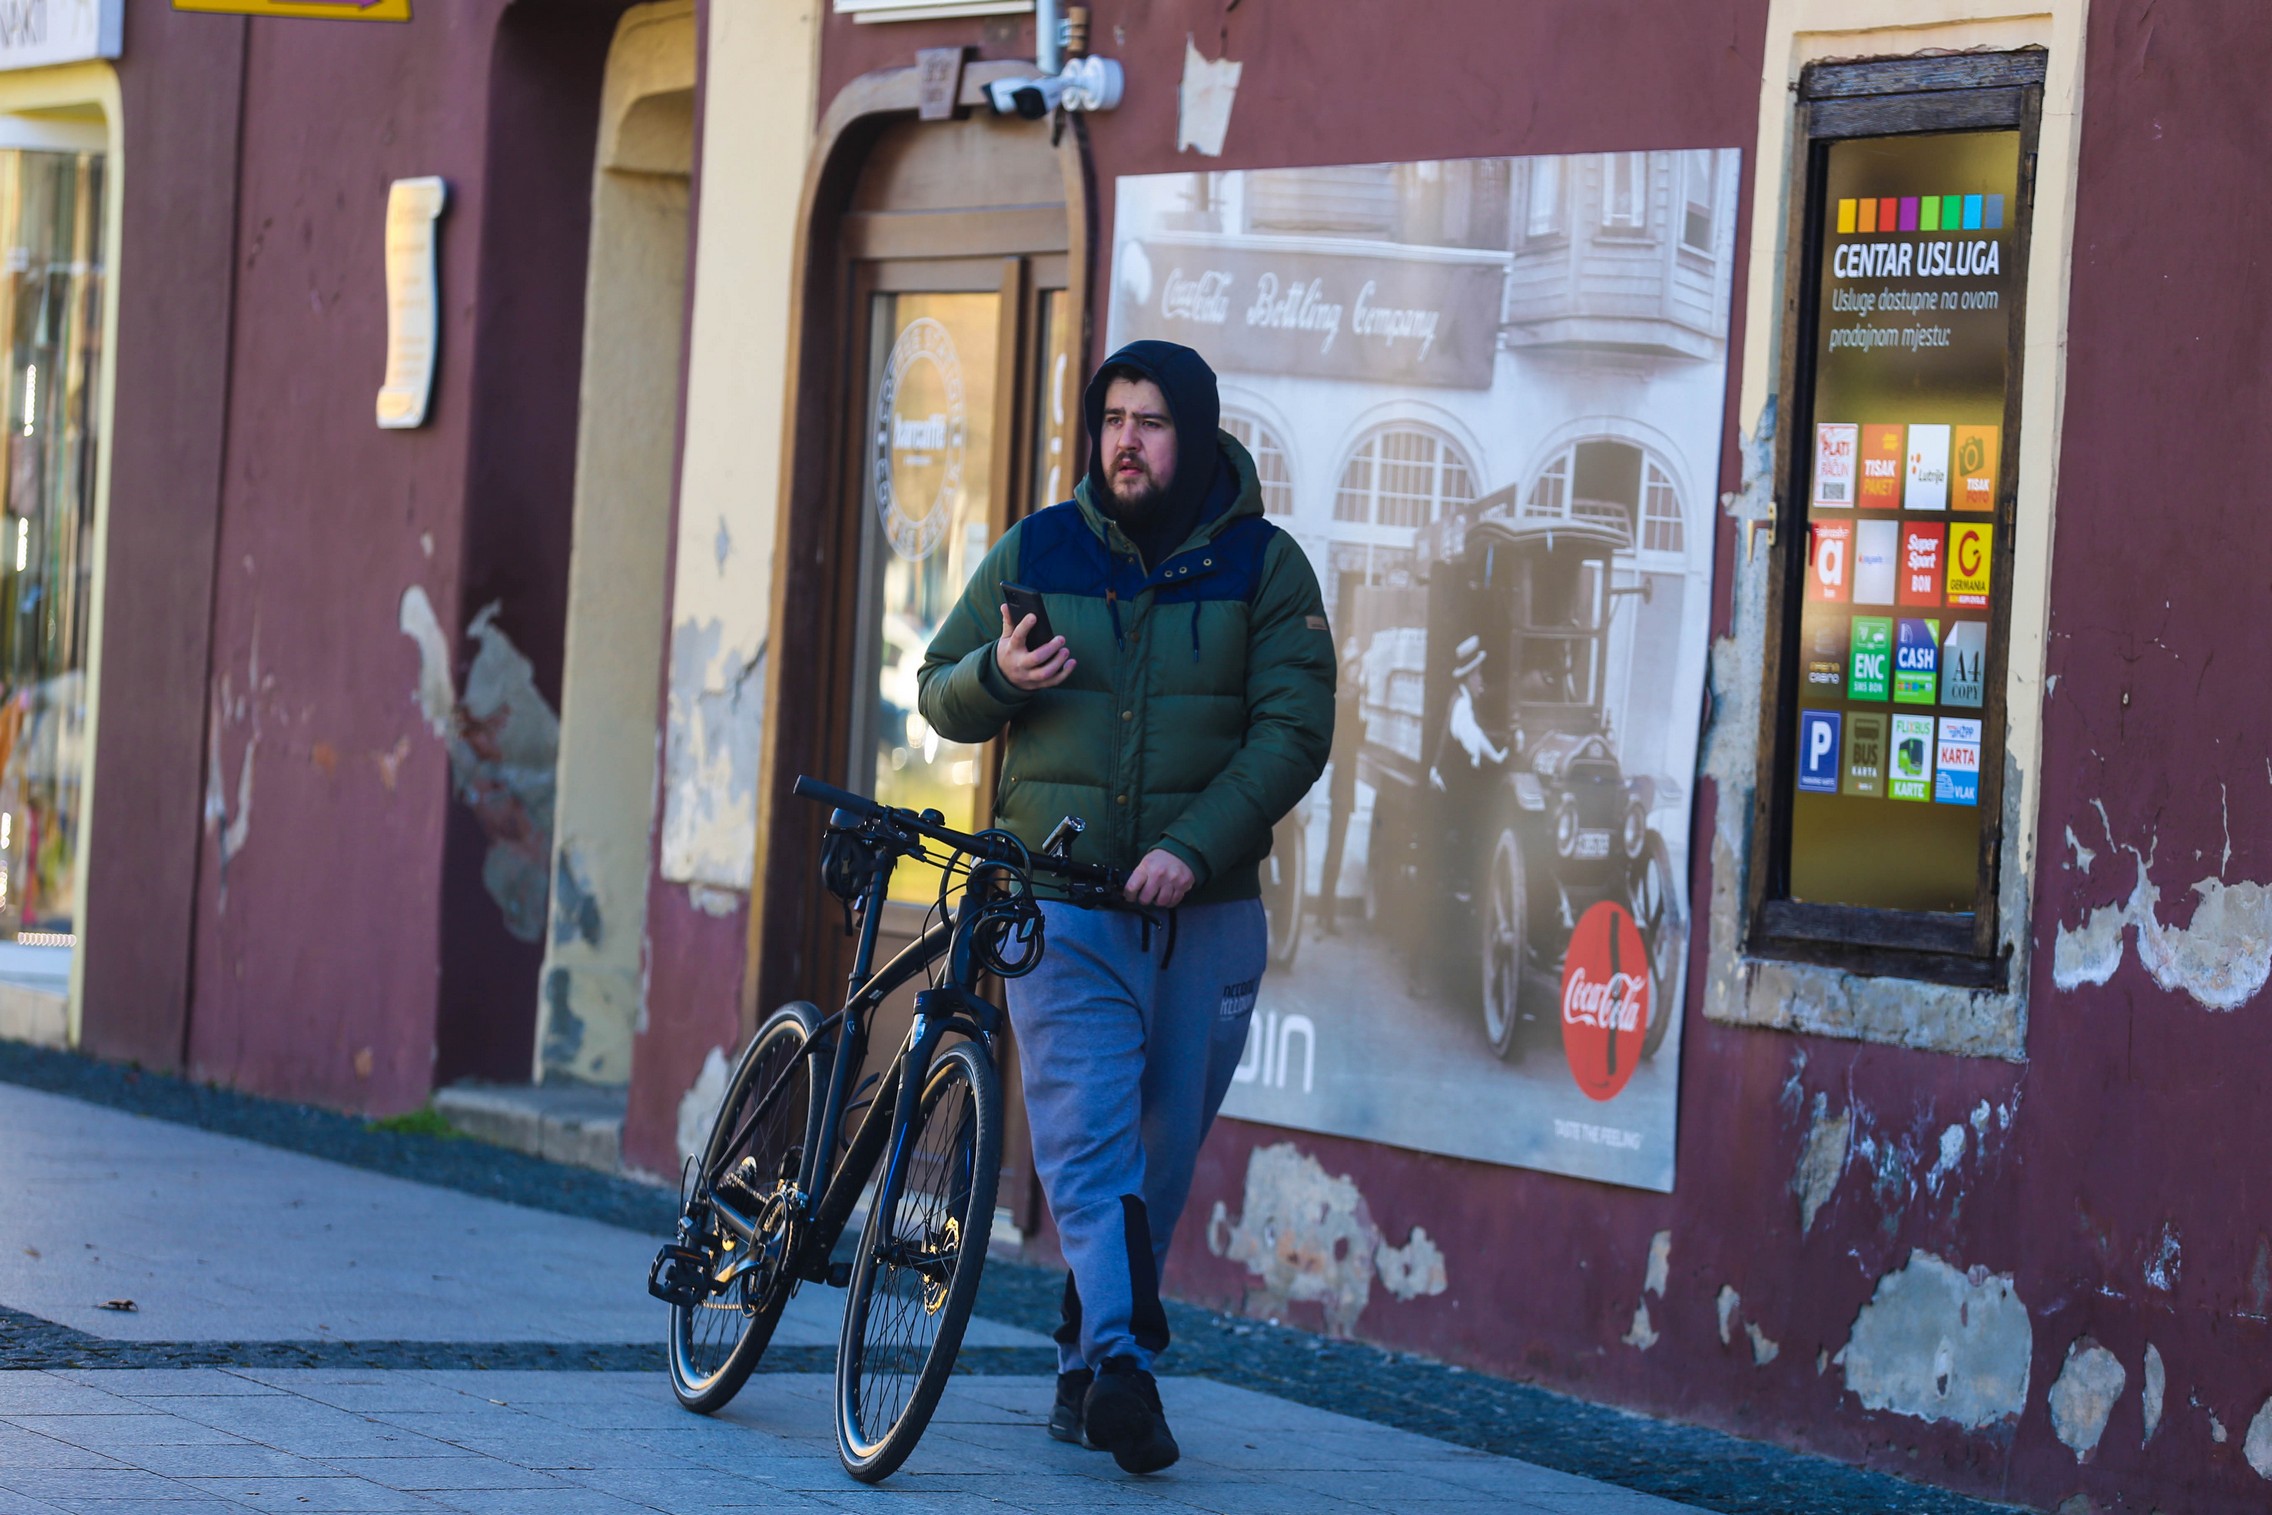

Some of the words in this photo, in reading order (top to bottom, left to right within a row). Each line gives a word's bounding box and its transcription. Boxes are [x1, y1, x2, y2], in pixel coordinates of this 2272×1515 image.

[1833, 242, 1914, 279] CENTAR
[1916, 240, 2000, 277] USLUGA
[1832, 286, 1877, 317] Usluge
[1878, 286, 1939, 317] dostupne
[1940, 290, 1959, 311] na
[1961, 290, 1999, 310] ovom
[1247, 271, 1343, 356] Bottling
[1352, 280, 1441, 362] Company
[1828, 323, 1899, 353] prodajnom
[1900, 322, 1952, 352] mjestu:
[1864, 460, 1896, 477] TISAK
[1967, 477, 1991, 492] TISAK
[1906, 533, 1940, 555] Super
[1906, 551, 1937, 571] Sport
[1911, 575, 1931, 593] BON
[1950, 579, 1987, 592] GERMANIA
[1854, 652, 1886, 680] ENC
[1897, 646, 1935, 670] CASH
[1952, 649, 1982, 683] A4
[1951, 684, 1980, 700] COPY
[1896, 719, 1932, 736] FLIXBUS
[1809, 720, 1833, 772] P
[1852, 743, 1879, 766] BUS
[1941, 747, 1976, 765] KARTA
[1893, 781, 1926, 799] KARTE
[1954, 785, 1976, 800] VLAK
